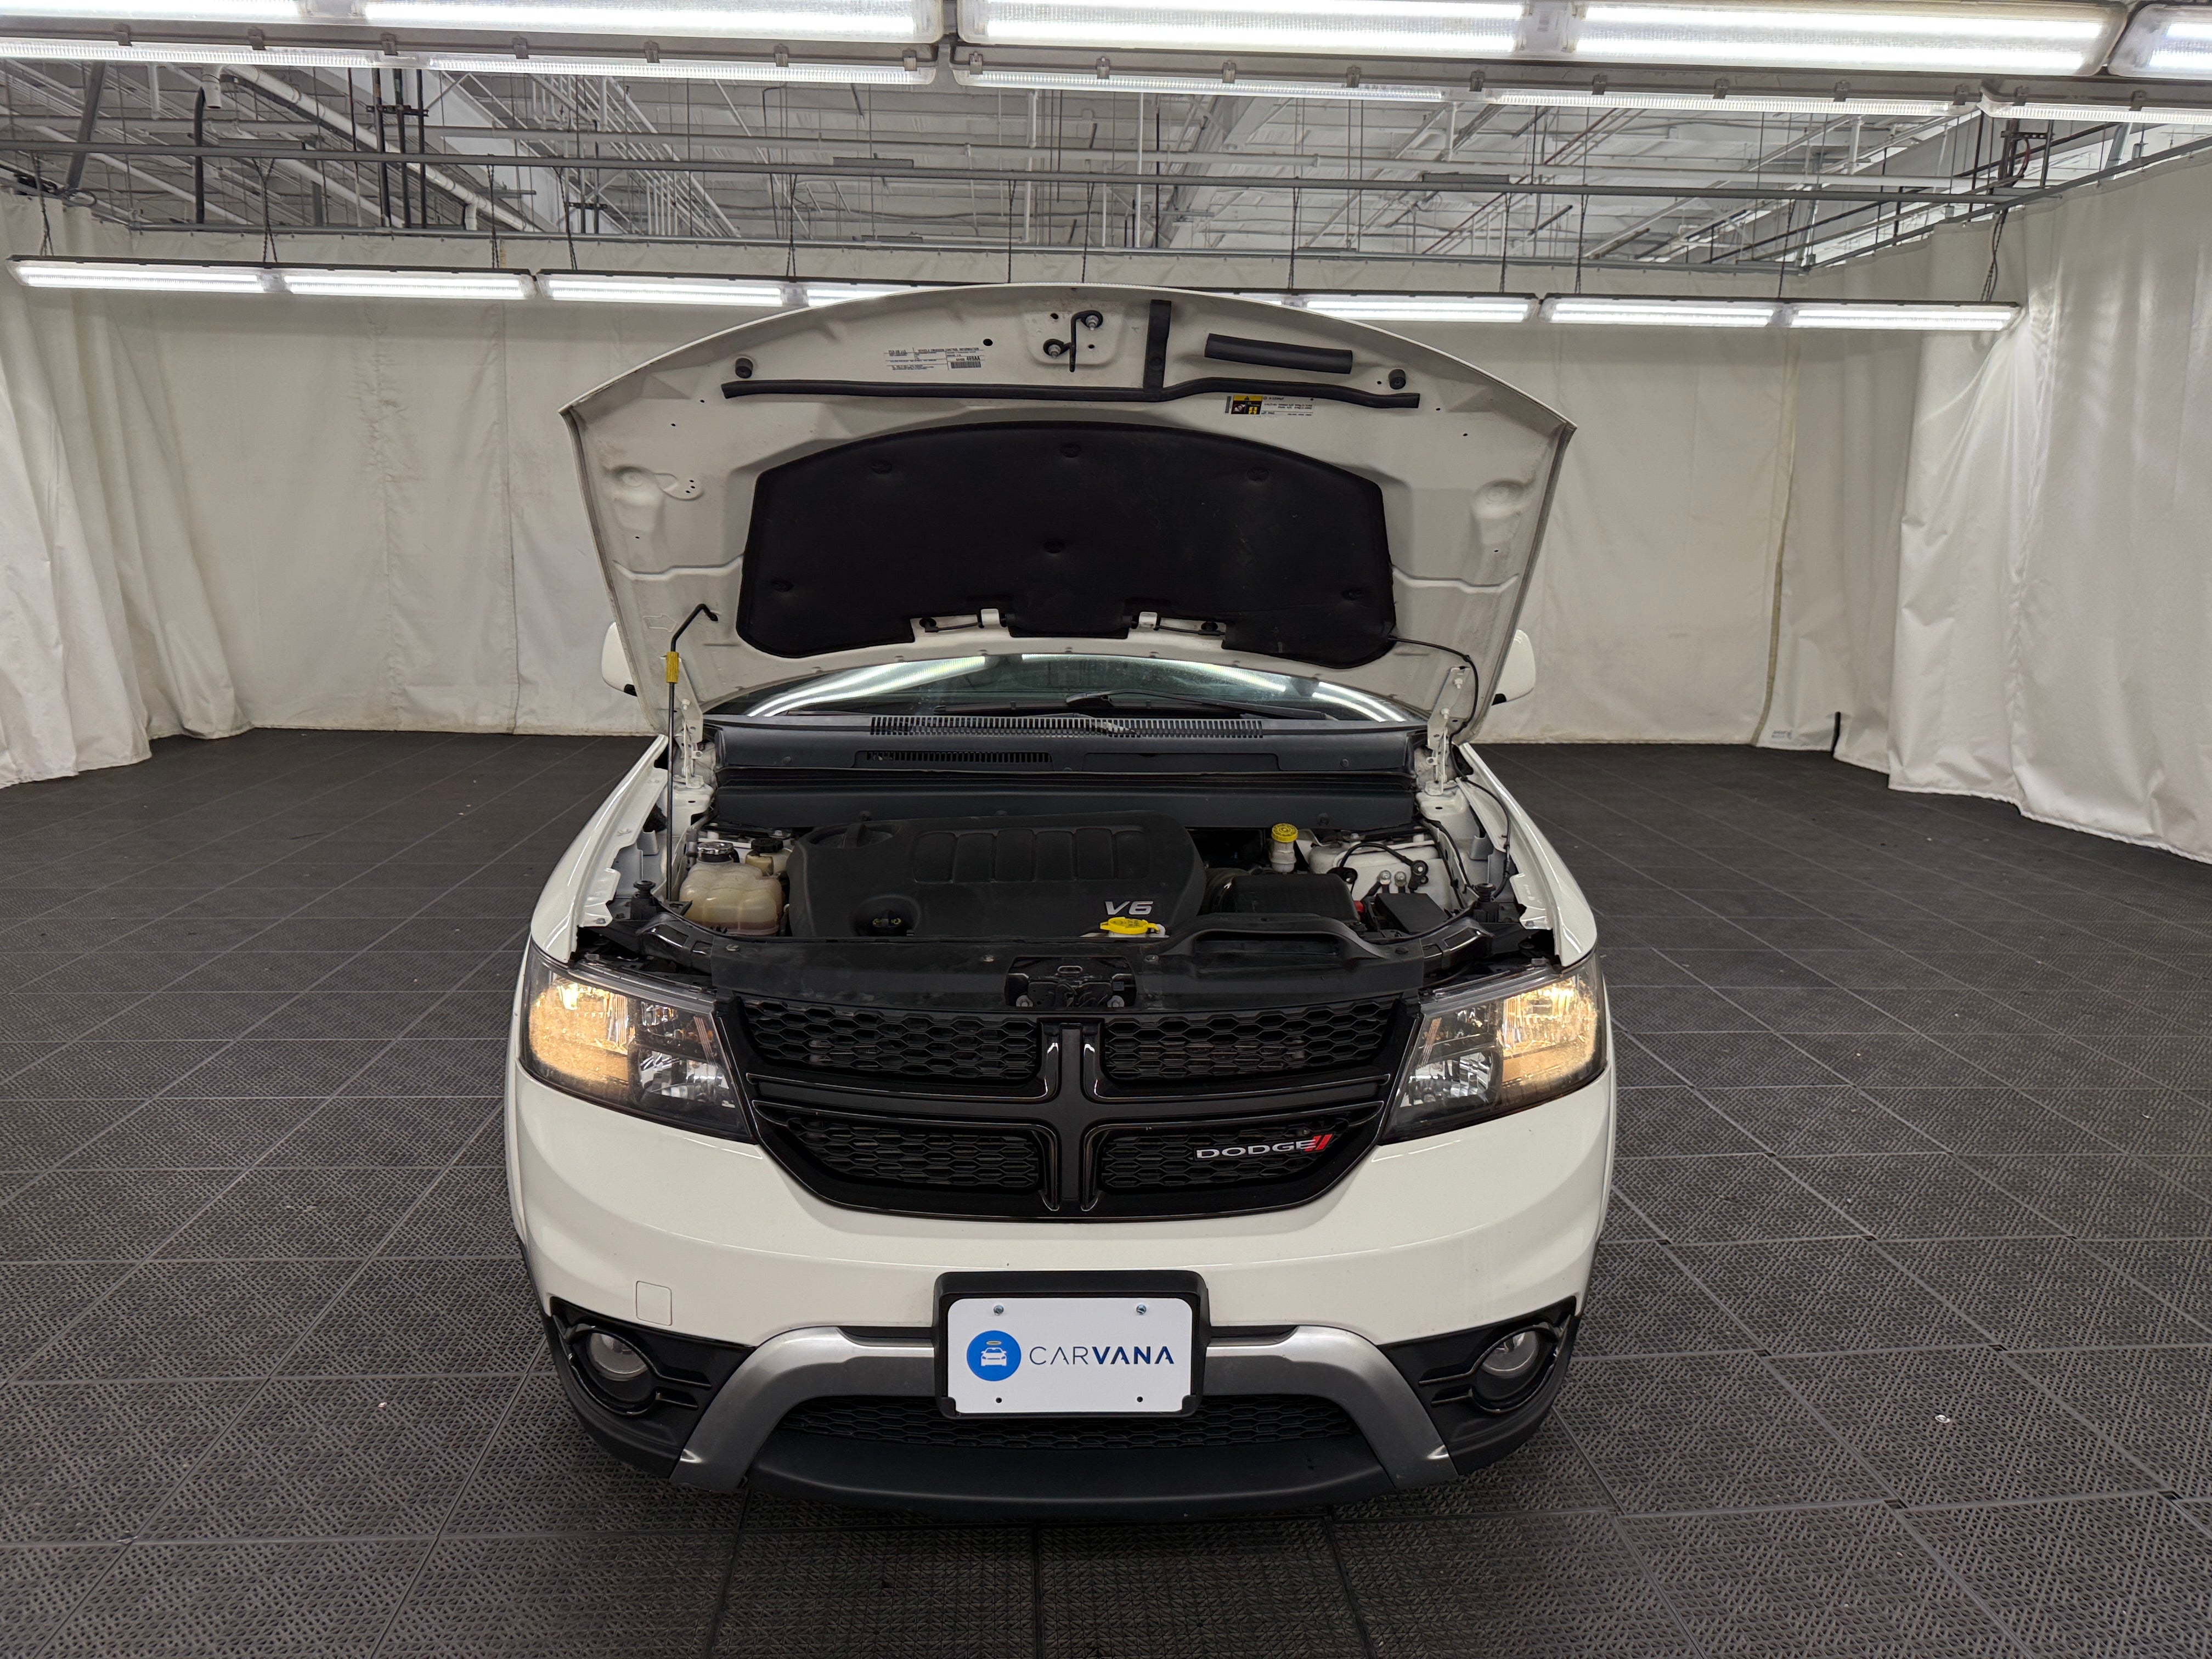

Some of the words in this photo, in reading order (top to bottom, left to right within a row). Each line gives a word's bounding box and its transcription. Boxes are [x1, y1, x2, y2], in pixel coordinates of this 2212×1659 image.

[1105, 901, 1154, 915] V6
[1197, 1139, 1317, 1159] DODGE
[1030, 1346, 1175, 1365] CARVANA
